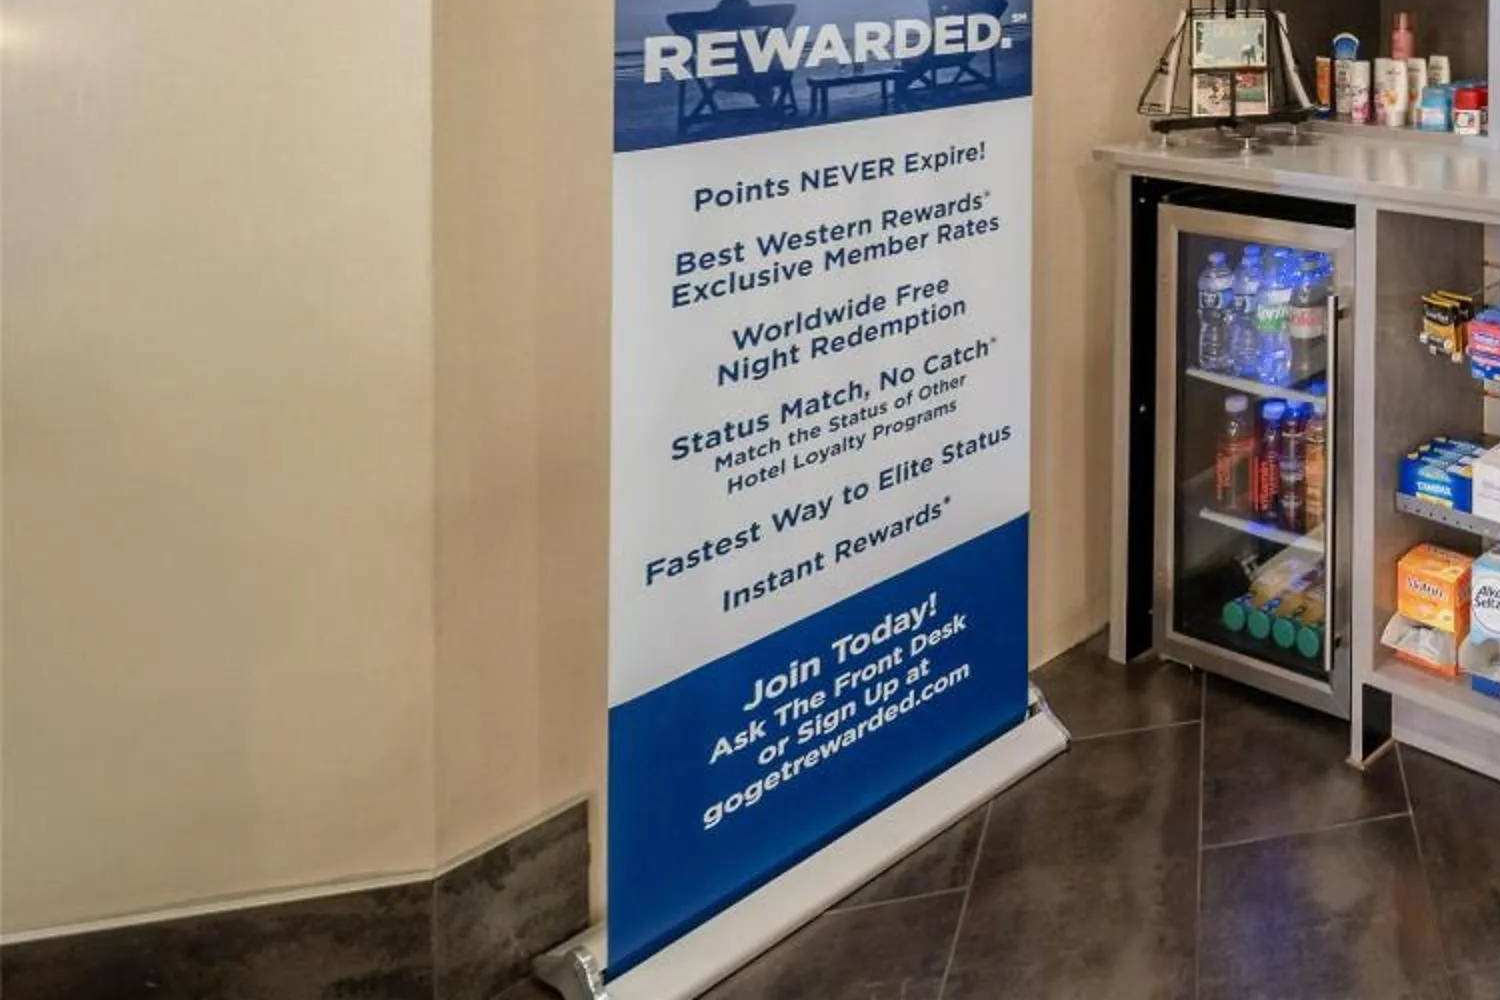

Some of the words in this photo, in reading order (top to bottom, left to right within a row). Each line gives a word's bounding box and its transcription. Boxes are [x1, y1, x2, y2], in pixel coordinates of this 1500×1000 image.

[644, 13, 1012, 83] REWARDED.
[695, 176, 789, 211] Points
[801, 158, 894, 192] NEVER
[904, 142, 985, 174] Expire!
[672, 258, 812, 308] Exclusive
[825, 232, 929, 270] Member
[937, 216, 1000, 244] Rates
[676, 241, 745, 276] Best
[757, 218, 871, 257] Western
[718, 344, 800, 386] Night
[811, 299, 965, 359] Redemption
[732, 294, 886, 350] Worldwide
[896, 277, 949, 306] Free
[672, 414, 770, 460] Status
[781, 381, 870, 424] Match,
[879, 367, 914, 391] No
[715, 439, 781, 472] Match
[789, 425, 821, 446] the
[829, 401, 888, 432] Status
[895, 391, 913, 409] of
[918, 374, 967, 400] Other
[728, 461, 785, 494] Hotel
[794, 434, 866, 470] Loyalty
[873, 401, 957, 441] Programs
[645, 522, 761, 585] Fastest
[771, 496, 833, 533] Way
[843, 481, 869, 504] to
[878, 454, 933, 491] Elite
[941, 424, 1012, 464] Status
[723, 552, 825, 612] Instant
[709, 719, 767, 764] Ask
[775, 689, 826, 727] The
[835, 646, 904, 699] Front
[910, 612, 967, 656] Desk
[743, 654, 821, 711] Join
[832, 591, 938, 664] Today!
[703, 663, 969, 830] gogetrewarded.com
[758, 740, 790, 766] or
[798, 701, 857, 745] Sign
[864, 679, 899, 712] Up
[906, 658, 930, 684] at
